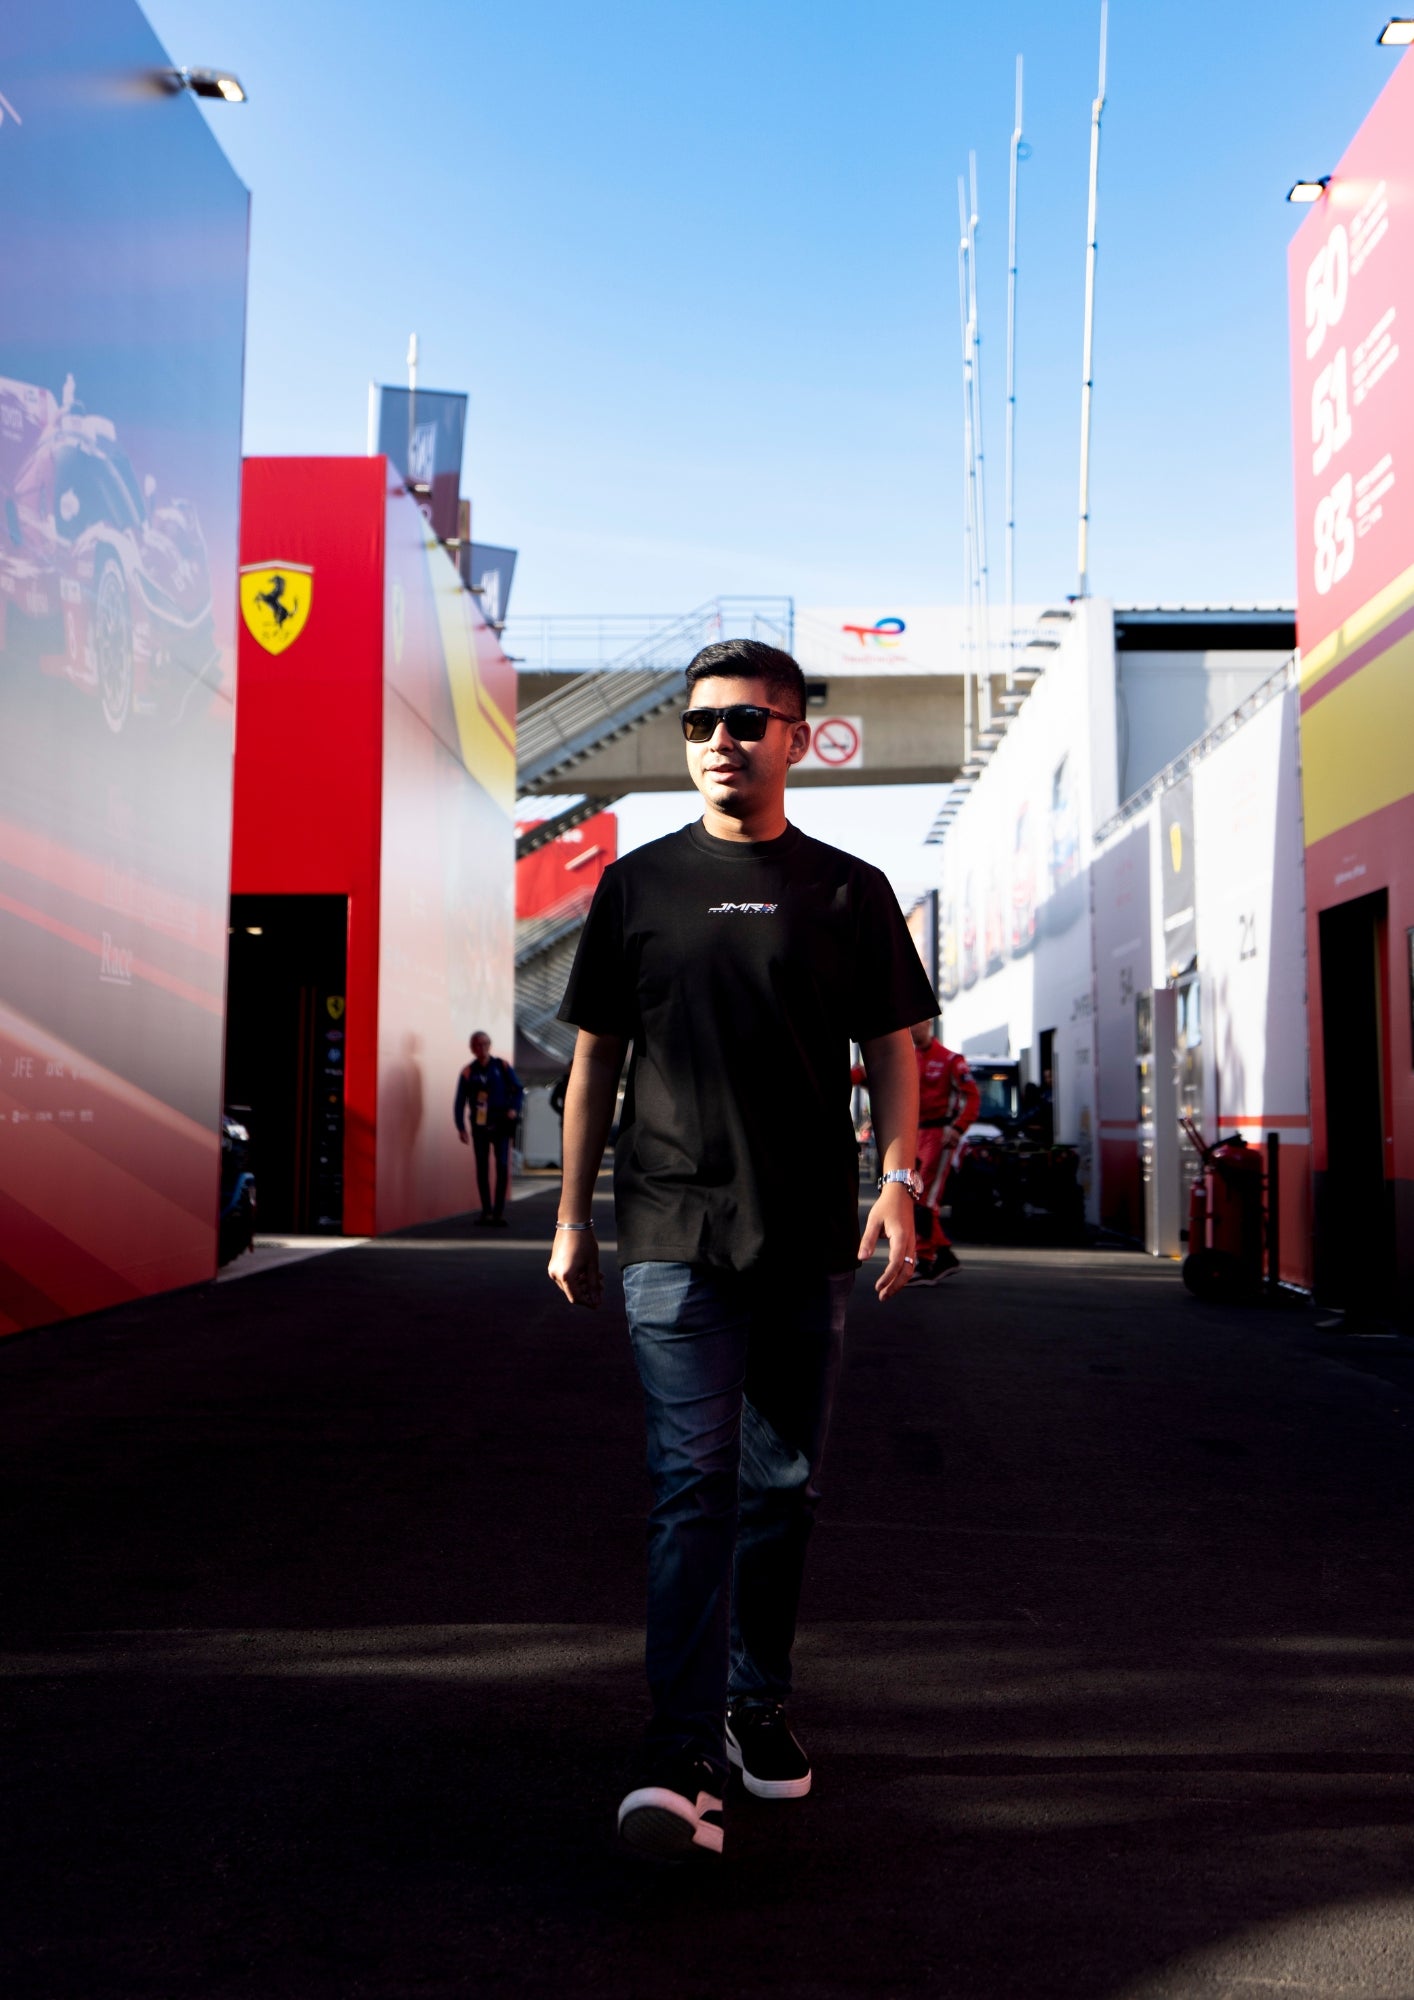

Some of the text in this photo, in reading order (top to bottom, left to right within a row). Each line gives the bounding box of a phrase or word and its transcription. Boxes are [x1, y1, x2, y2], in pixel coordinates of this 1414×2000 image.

[1305, 224, 1349, 360] 50
[1311, 345, 1352, 476] 51
[1314, 472, 1355, 595] 83
[708, 902, 765, 912] JMR
[100, 931, 133, 979] Race
[10, 1056, 33, 1079] JFE
